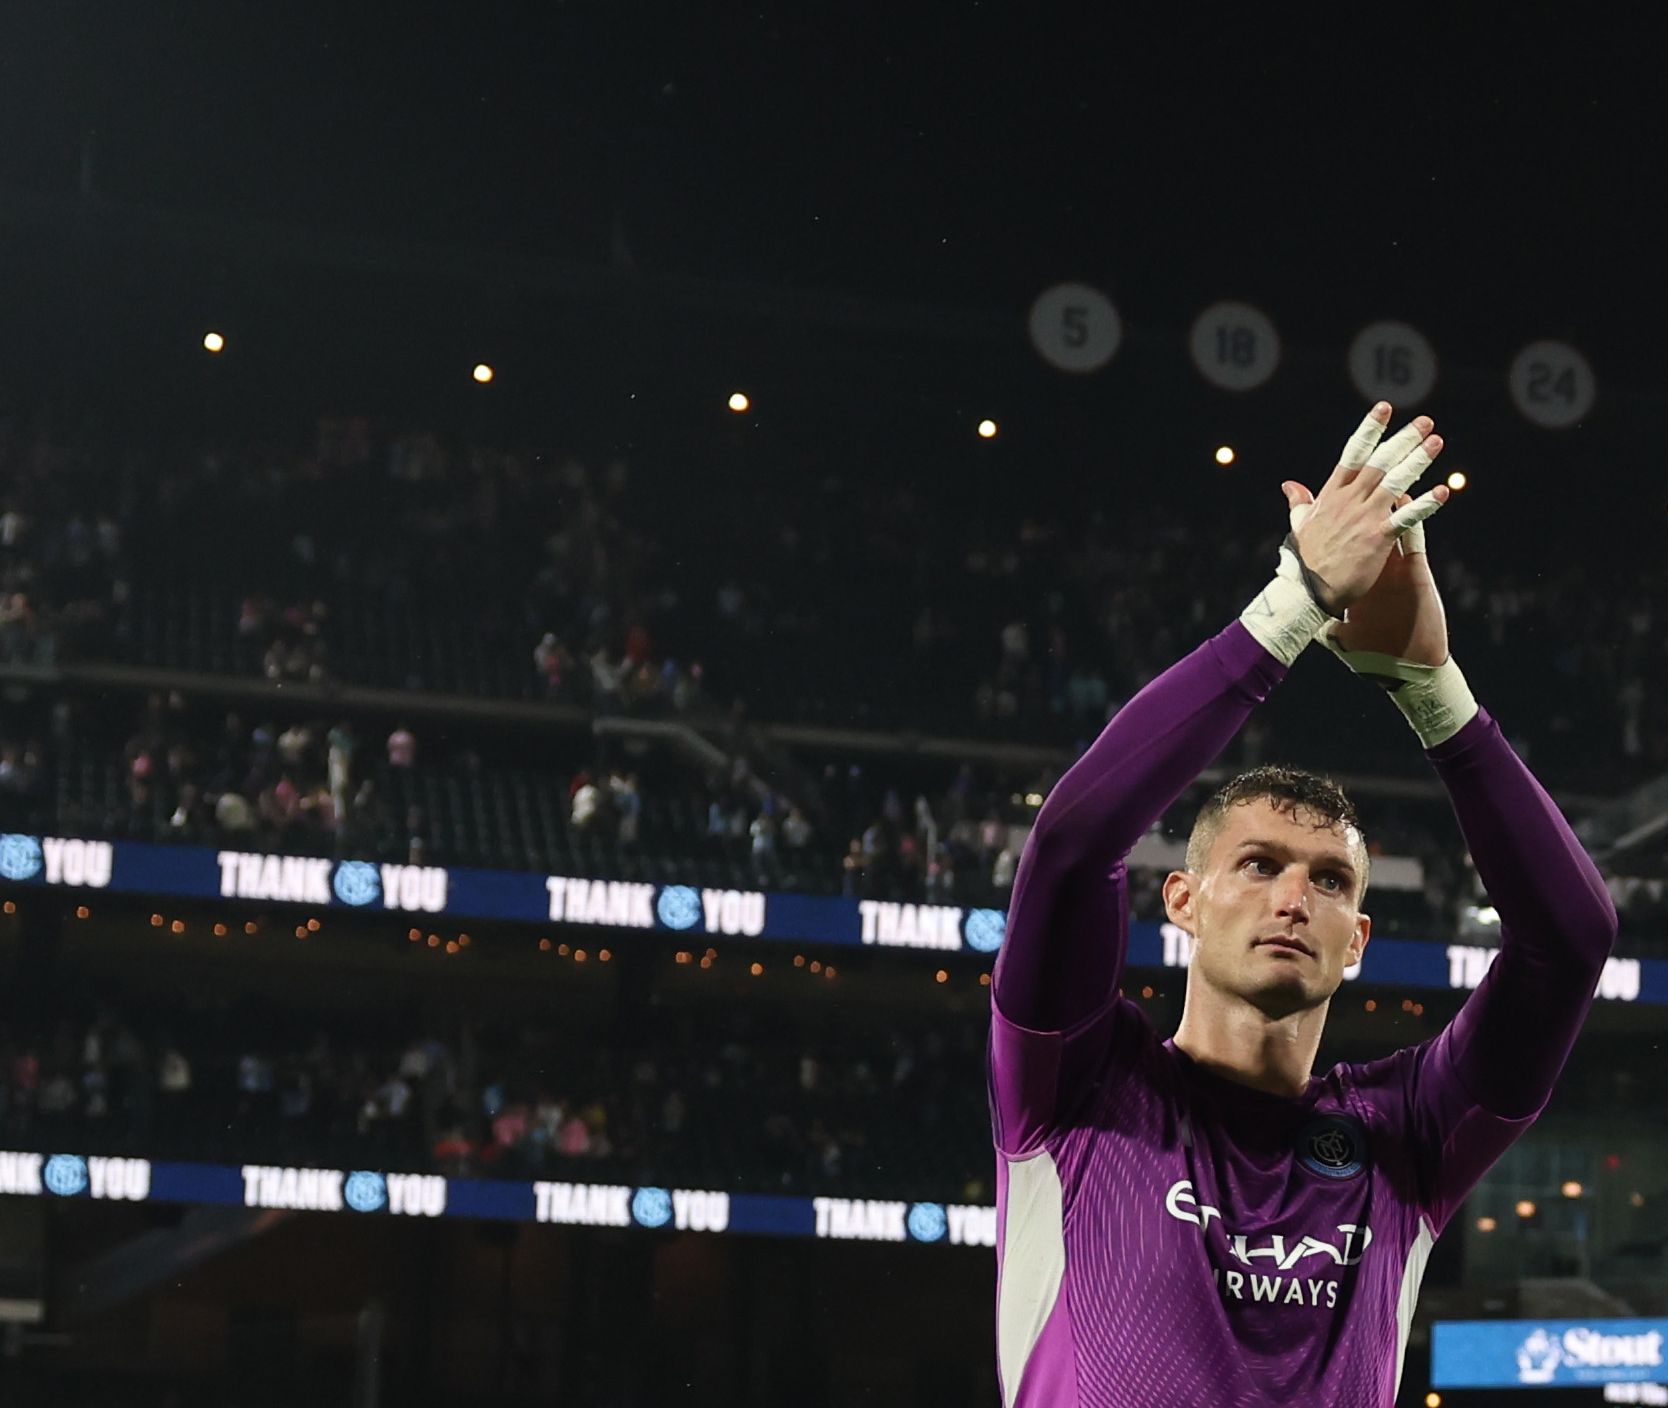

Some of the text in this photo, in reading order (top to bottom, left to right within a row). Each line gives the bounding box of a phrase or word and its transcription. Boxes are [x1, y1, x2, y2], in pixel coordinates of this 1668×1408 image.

[1062, 306, 1089, 348] 5
[1216, 325, 1256, 368] 18
[1375, 344, 1414, 387] 16
[1527, 362, 1576, 405] 24
[43, 838, 111, 887] YOU
[218, 852, 447, 911] THANK YOU
[546, 877, 764, 935] THANK YOU
[859, 901, 962, 950] THANK
[88, 1157, 150, 1200] YOU
[242, 1166, 445, 1216] THANK YOU
[534, 1182, 729, 1231] THANK YOU
[813, 1198, 906, 1240] THANK
[1165, 1180, 1373, 1270] ETHAD
[1213, 1268, 1338, 1309] IRWAYS
[1563, 1327, 1664, 1367] Stout
